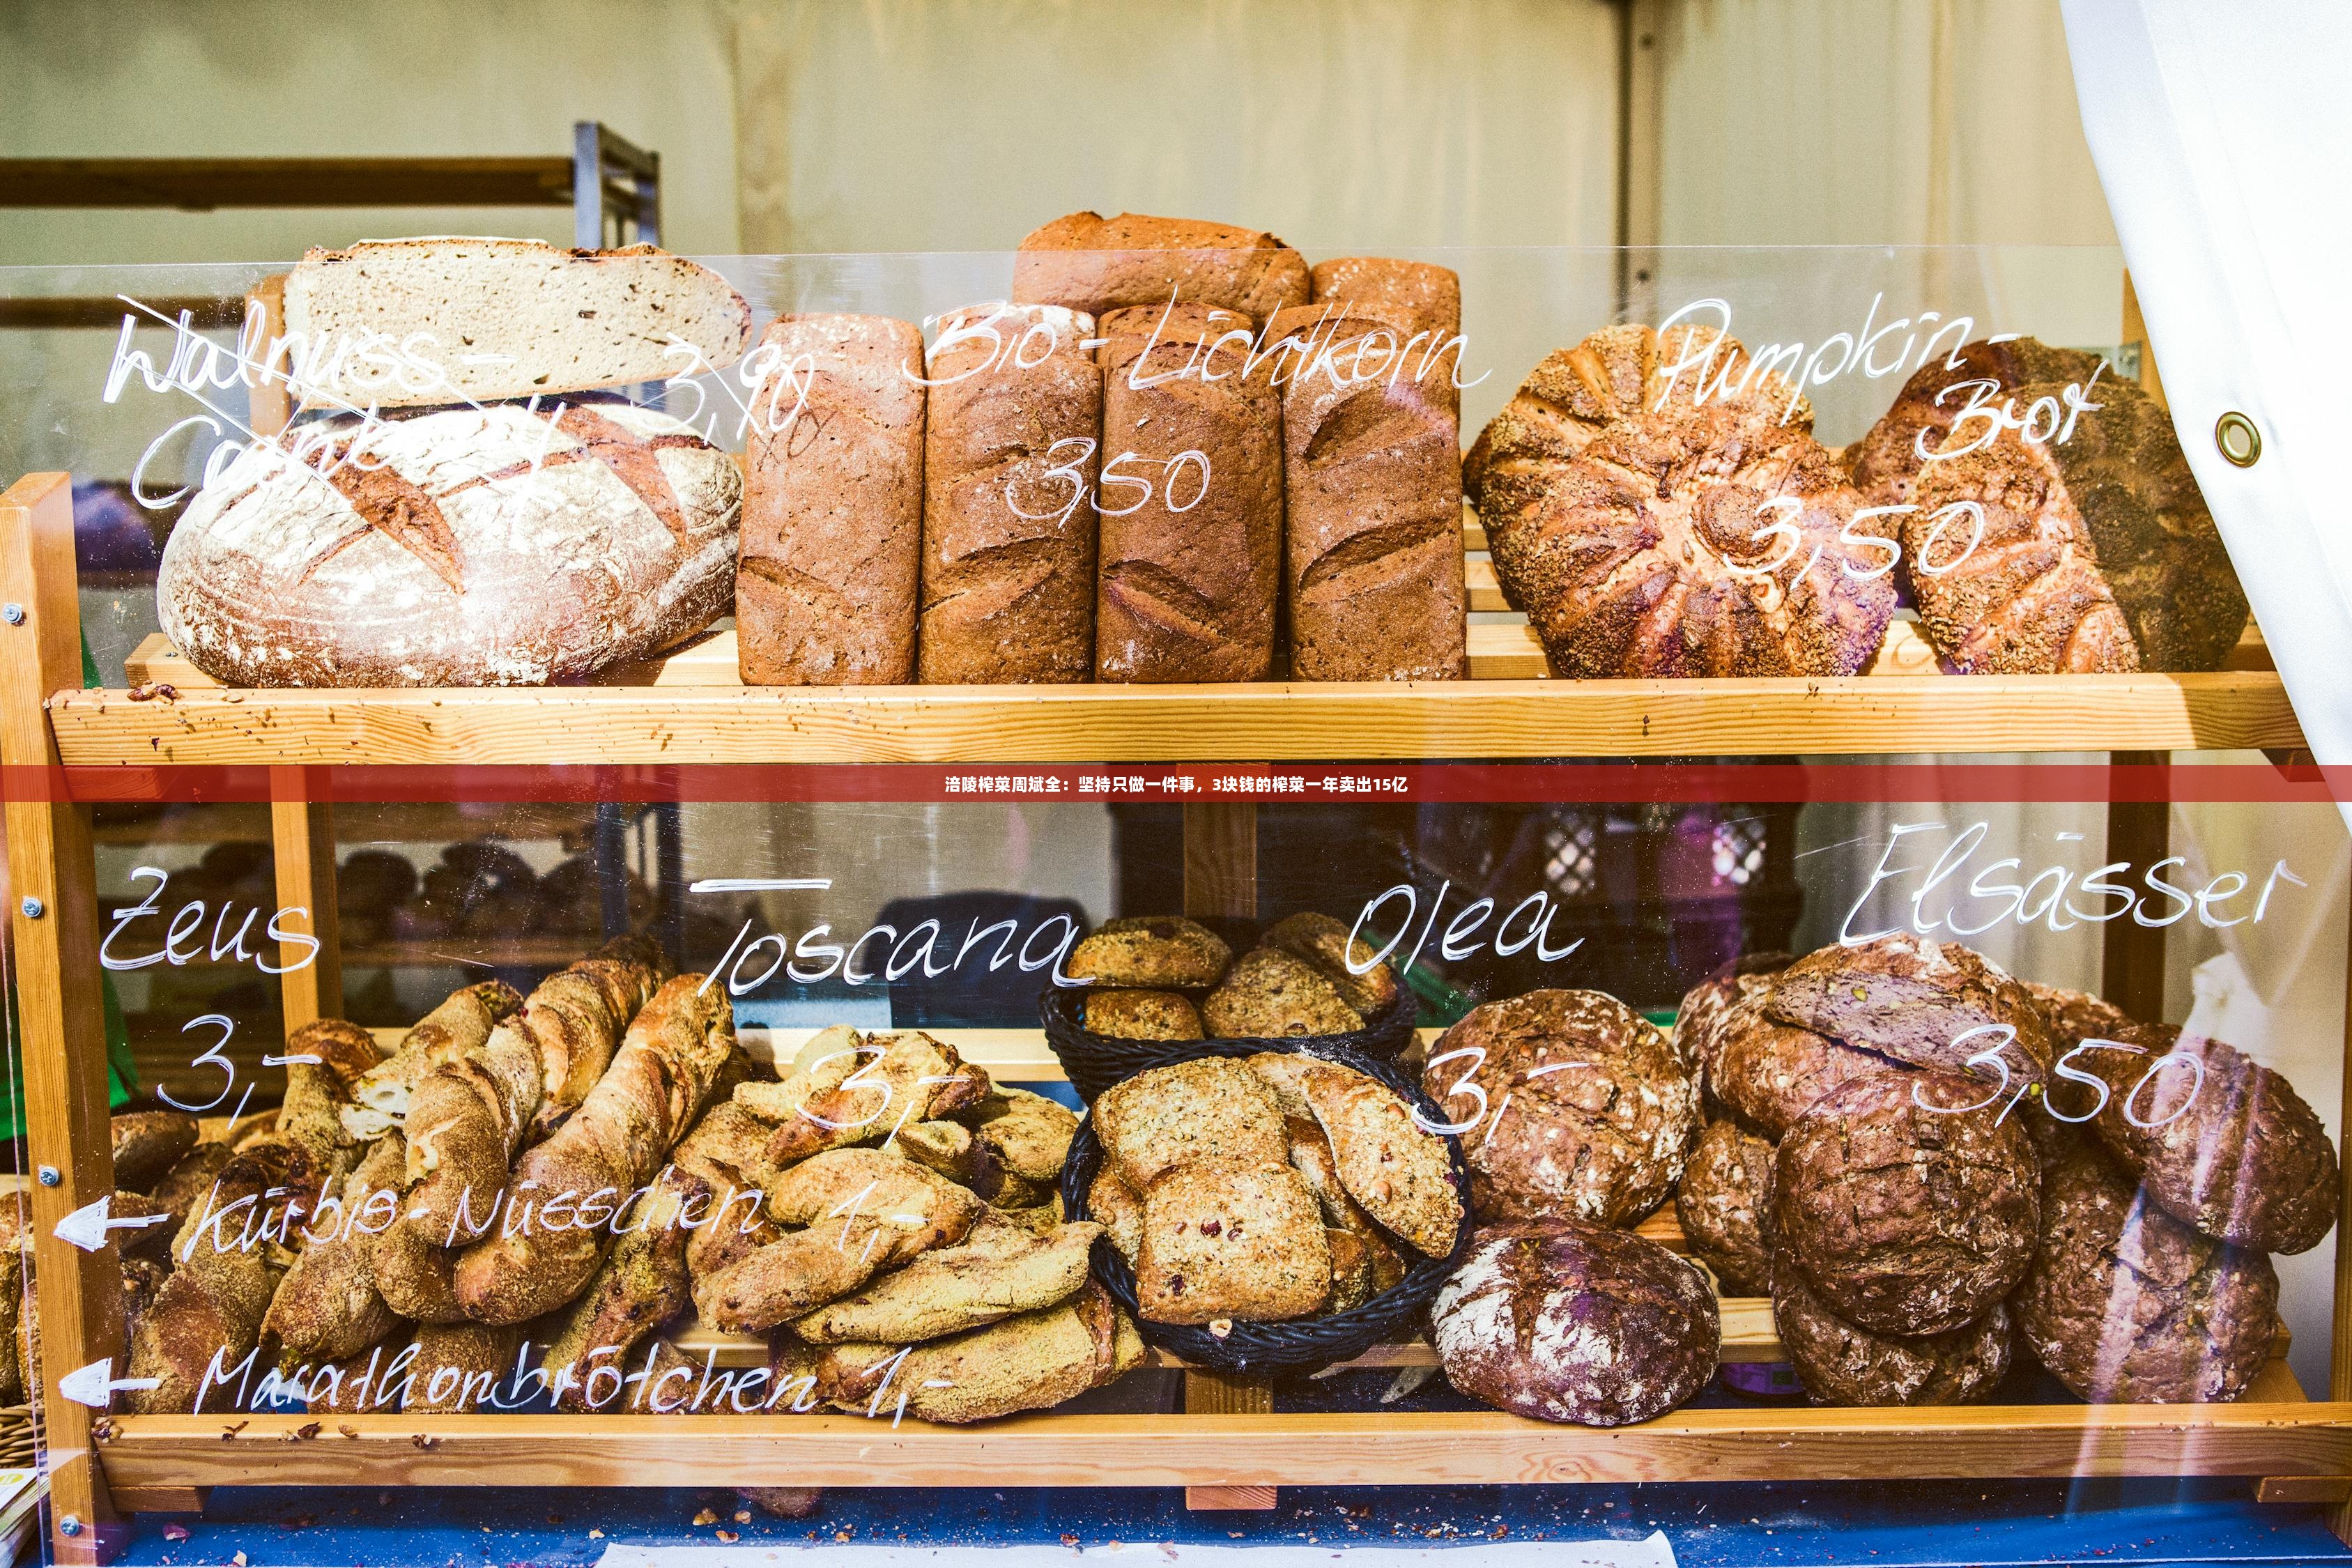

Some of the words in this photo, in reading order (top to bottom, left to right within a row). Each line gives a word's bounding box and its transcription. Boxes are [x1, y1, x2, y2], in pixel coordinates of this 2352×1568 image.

[1915, 360, 2109, 461] Brot
[1006, 436, 1210, 528] 3,50
[1723, 497, 1984, 590] 3,50
[100, 866, 321, 974] Zeus
[1345, 879, 1585, 975] Olea
[1839, 820, 2307, 947] Elsässer
[689, 878, 1097, 997] Toscana
[1912, 1024, 2204, 1128] 3,50
